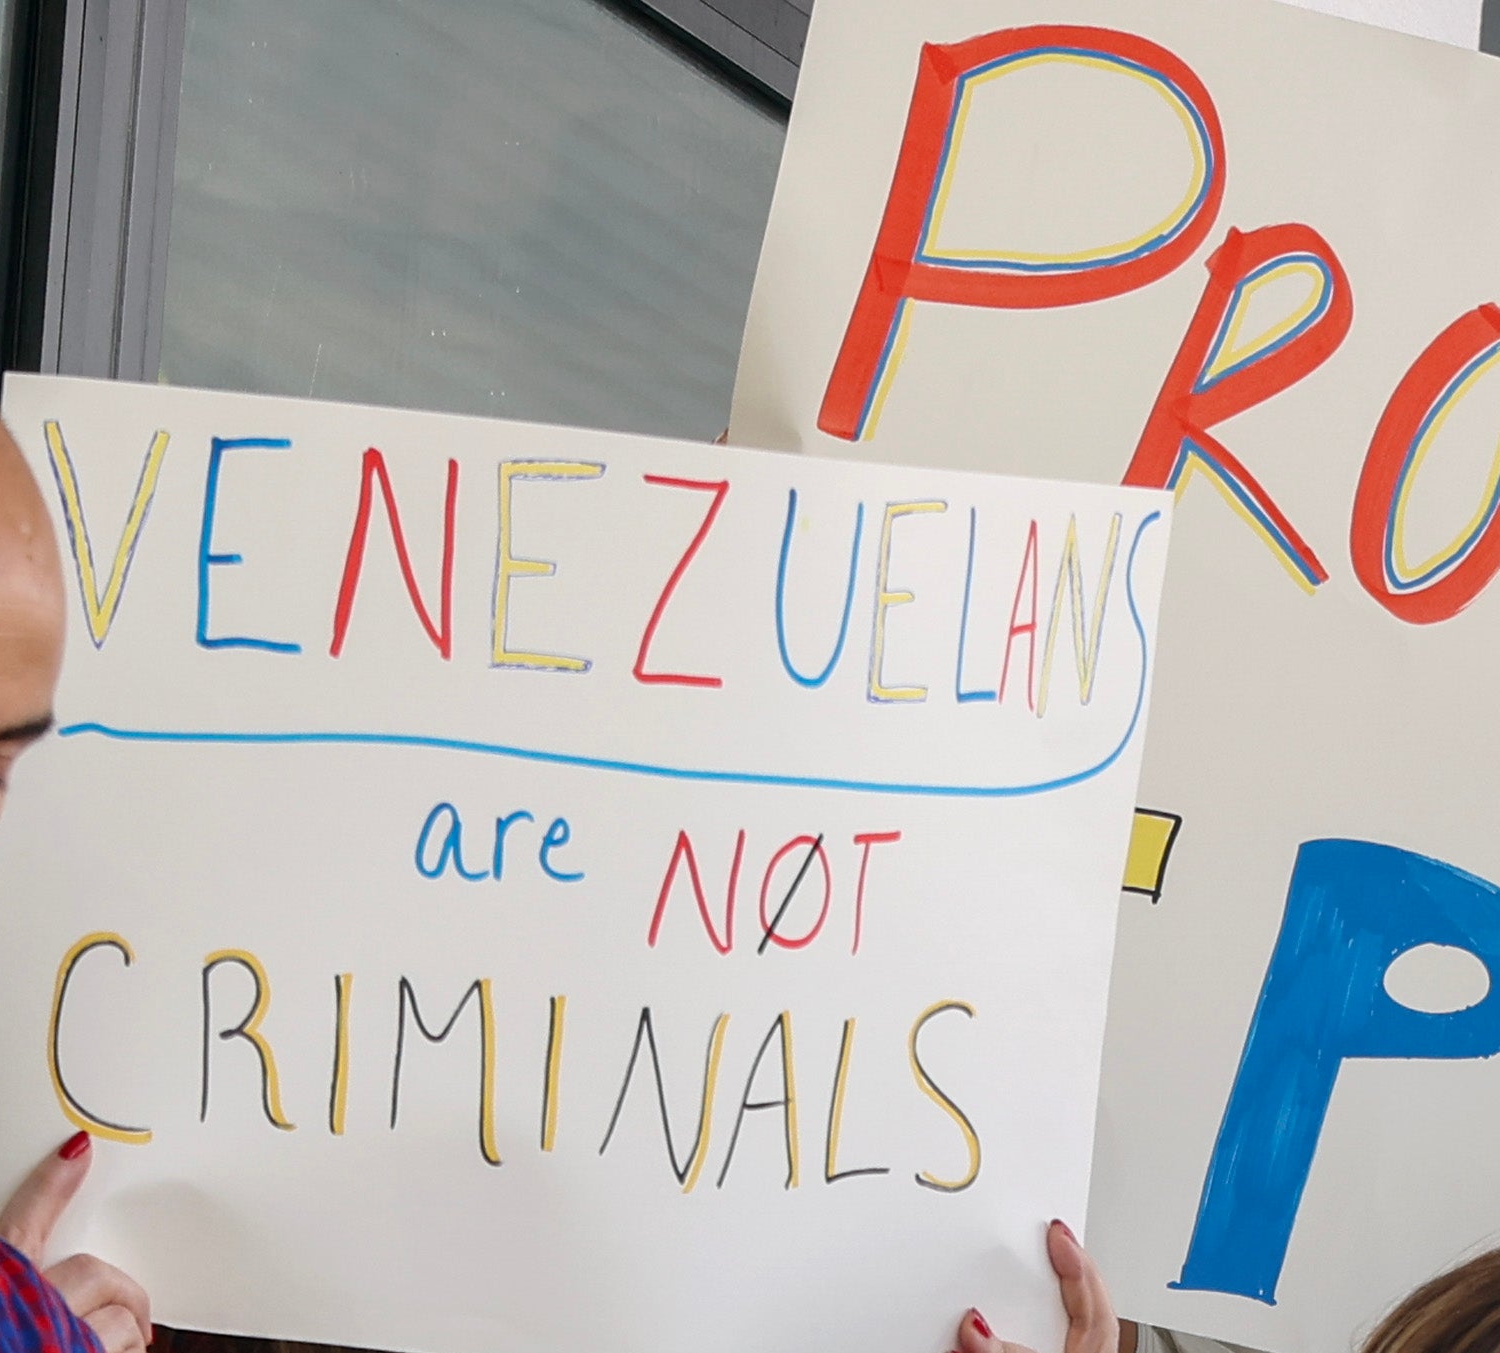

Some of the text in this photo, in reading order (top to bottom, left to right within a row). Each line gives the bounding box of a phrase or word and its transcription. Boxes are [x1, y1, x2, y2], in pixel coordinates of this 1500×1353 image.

[43, 419, 1162, 718] VENEZUELANS
[414, 803, 586, 883] are
[44, 931, 984, 1195] CRIMINALS
